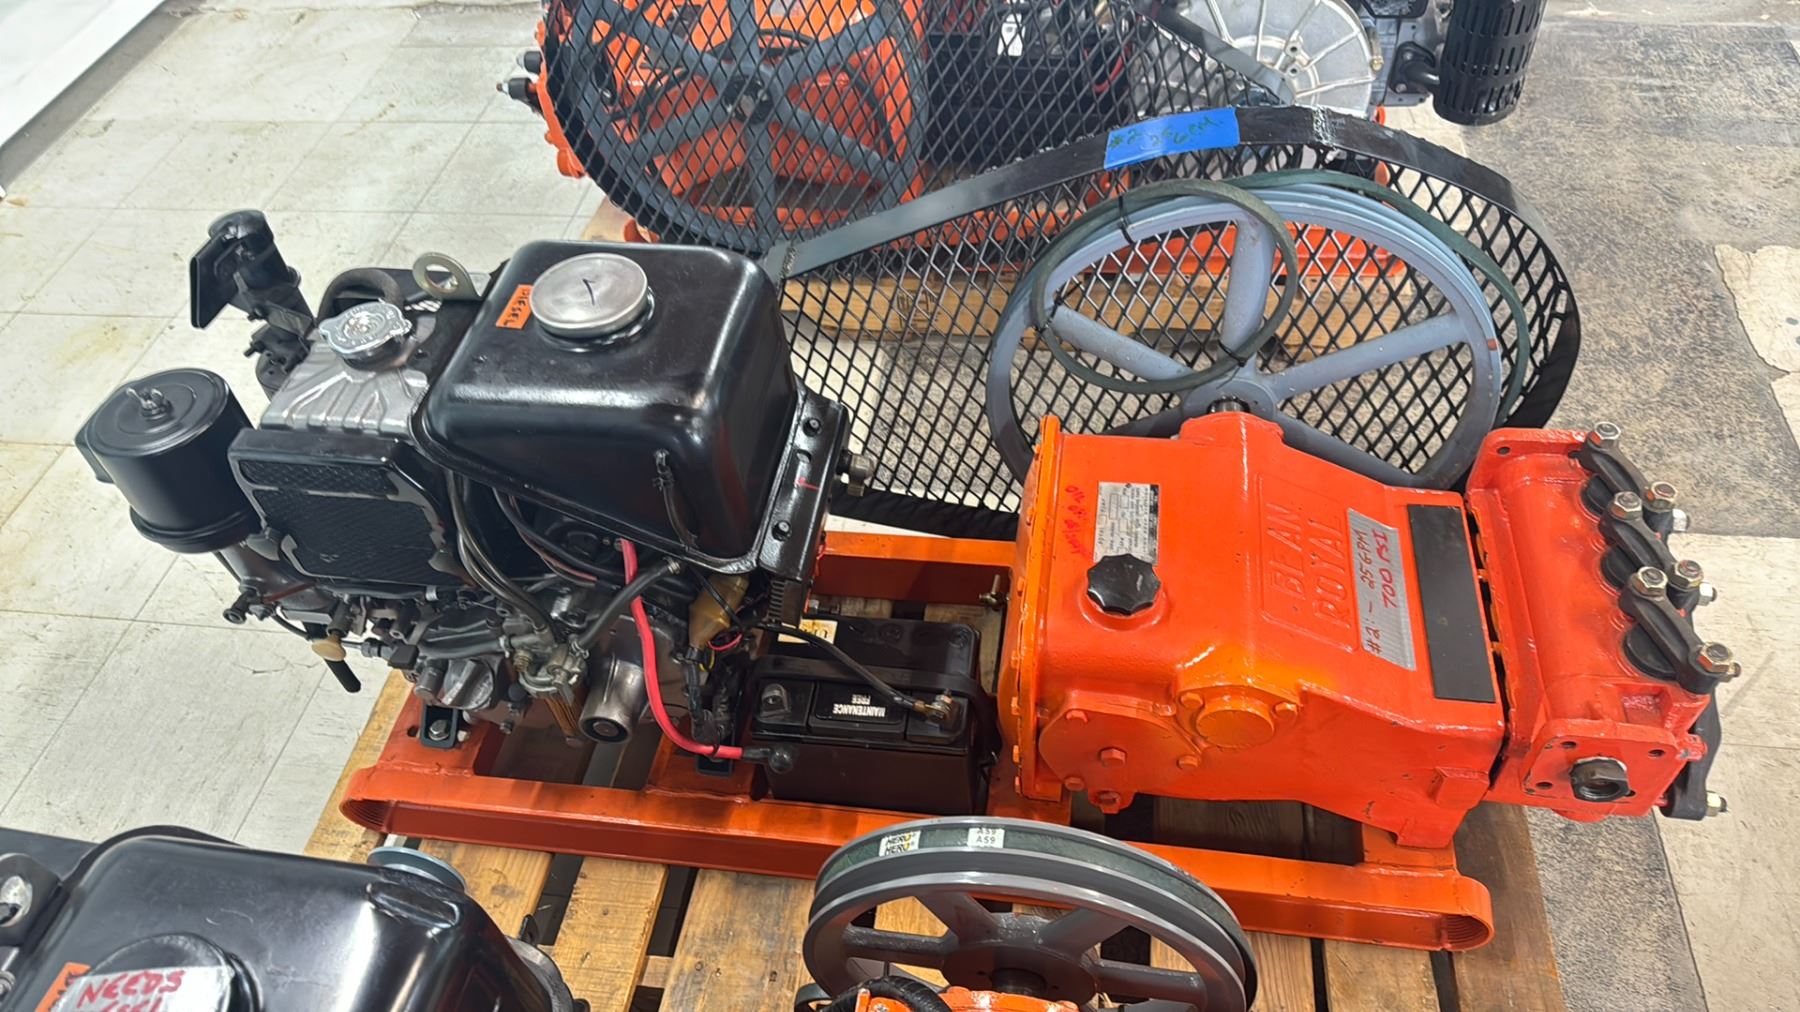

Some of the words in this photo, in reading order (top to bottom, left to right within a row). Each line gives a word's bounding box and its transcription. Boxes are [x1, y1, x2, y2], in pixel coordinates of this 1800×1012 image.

[502, 288, 531, 326] DIESEL
[1265, 503, 1307, 601] BEAN
[1372, 529, 1392, 564] PSI
[1307, 517, 1351, 629] ROYAL
[1378, 567, 1398, 609] 700
[833, 703, 886, 718] MAINTENANCE
[852, 693, 872, 705] FREE
[76, 969, 186, 1009] NEEDS
